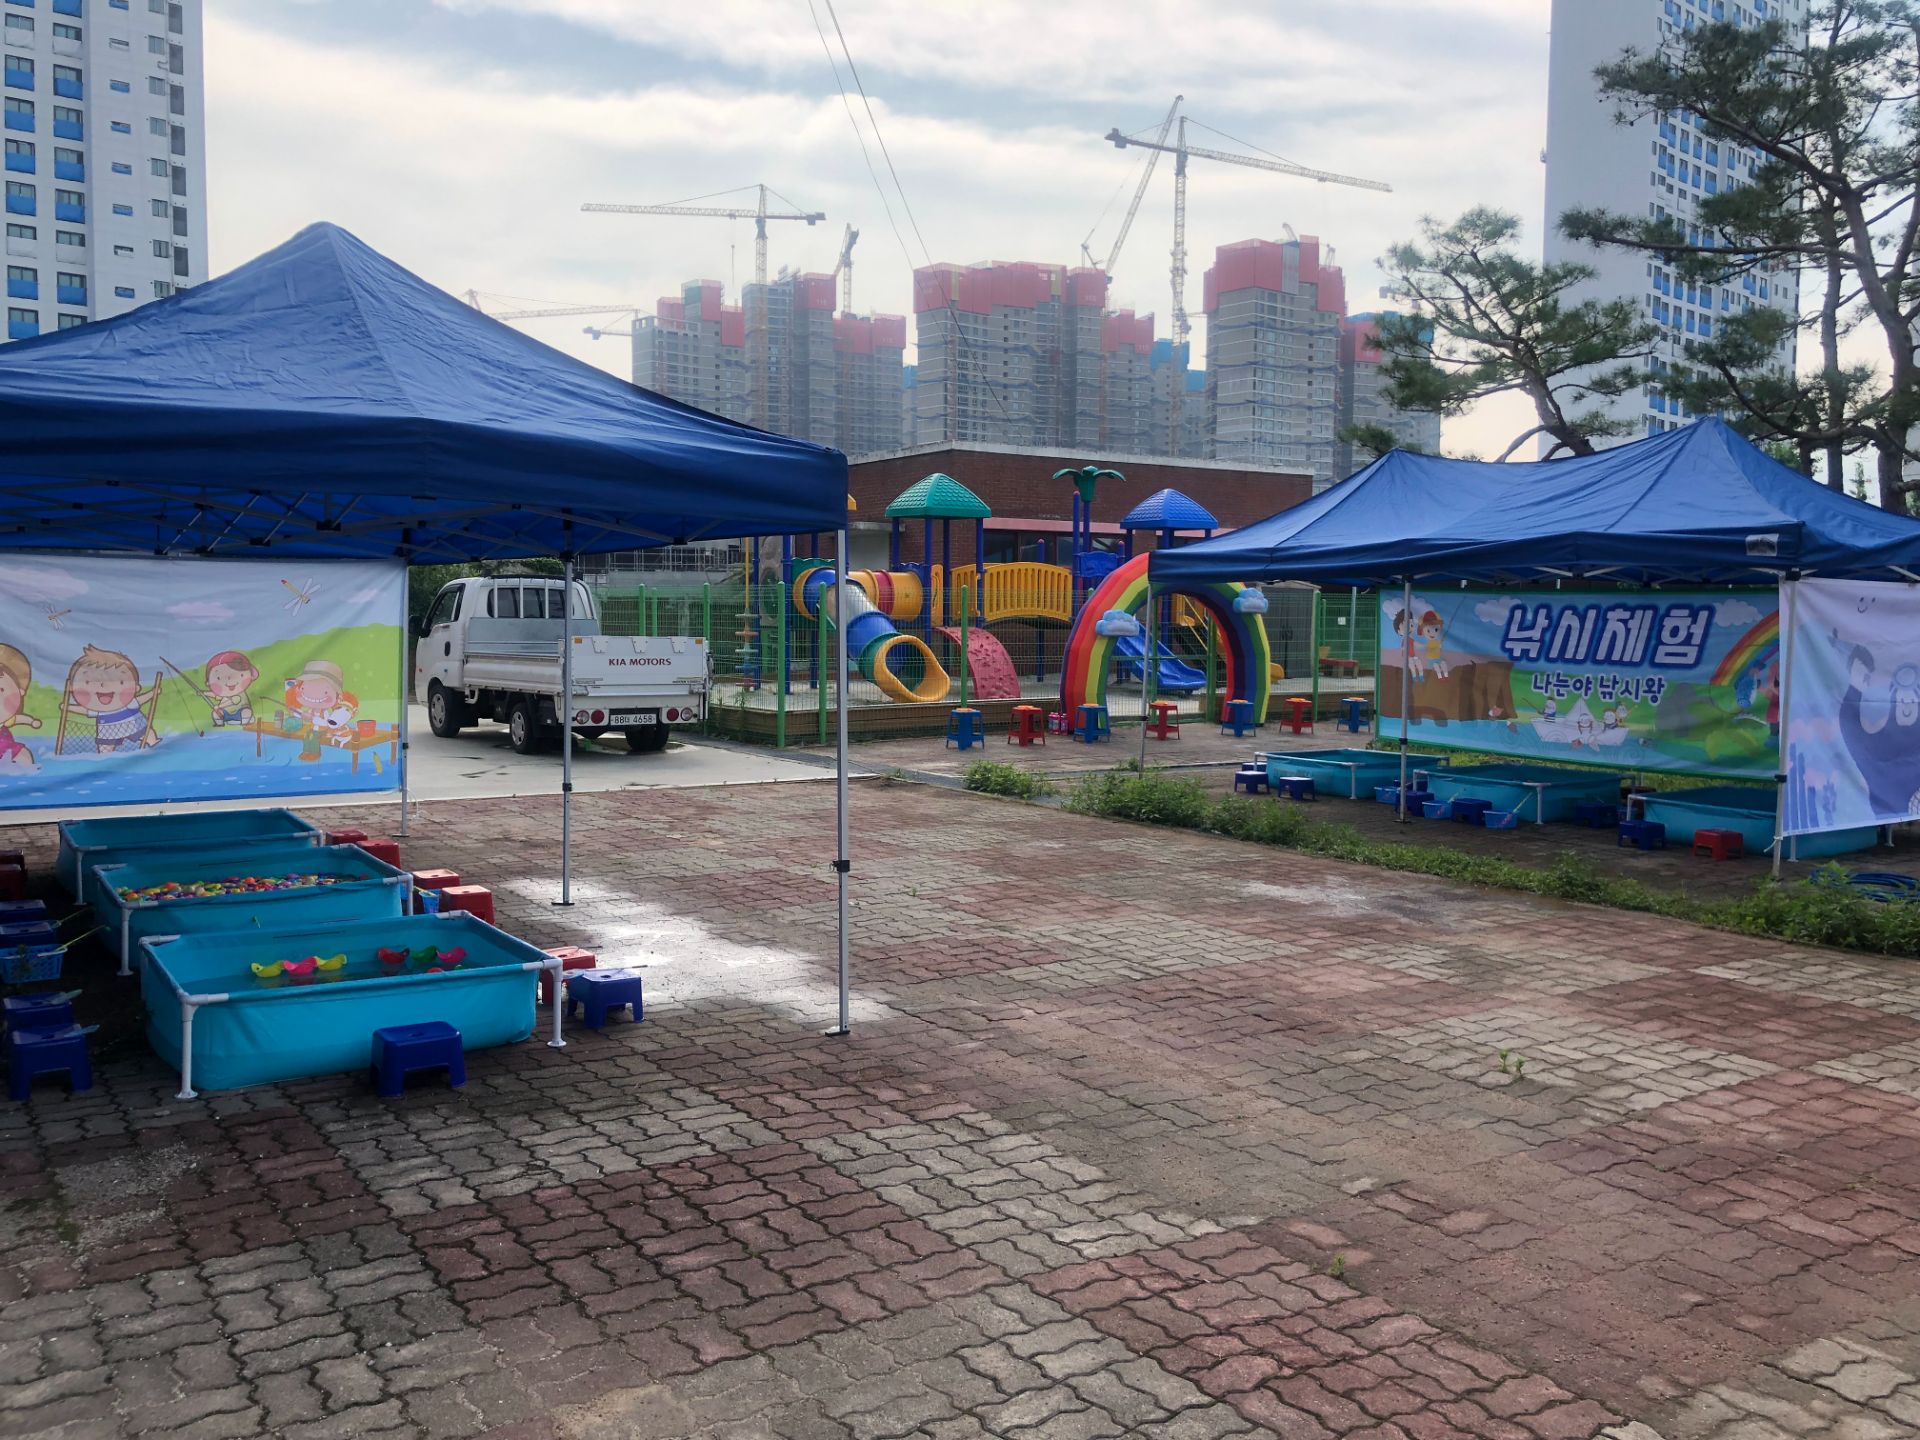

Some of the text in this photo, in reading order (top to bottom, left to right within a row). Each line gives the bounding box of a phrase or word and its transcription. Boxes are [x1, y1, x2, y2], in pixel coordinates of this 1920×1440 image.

[1503, 605, 1711, 667] 낚시체험
[608, 658, 672, 666] KIA MOTORS
[1532, 671, 1666, 705] 나는야 낚시왕
[632, 714, 653, 724] 4658
